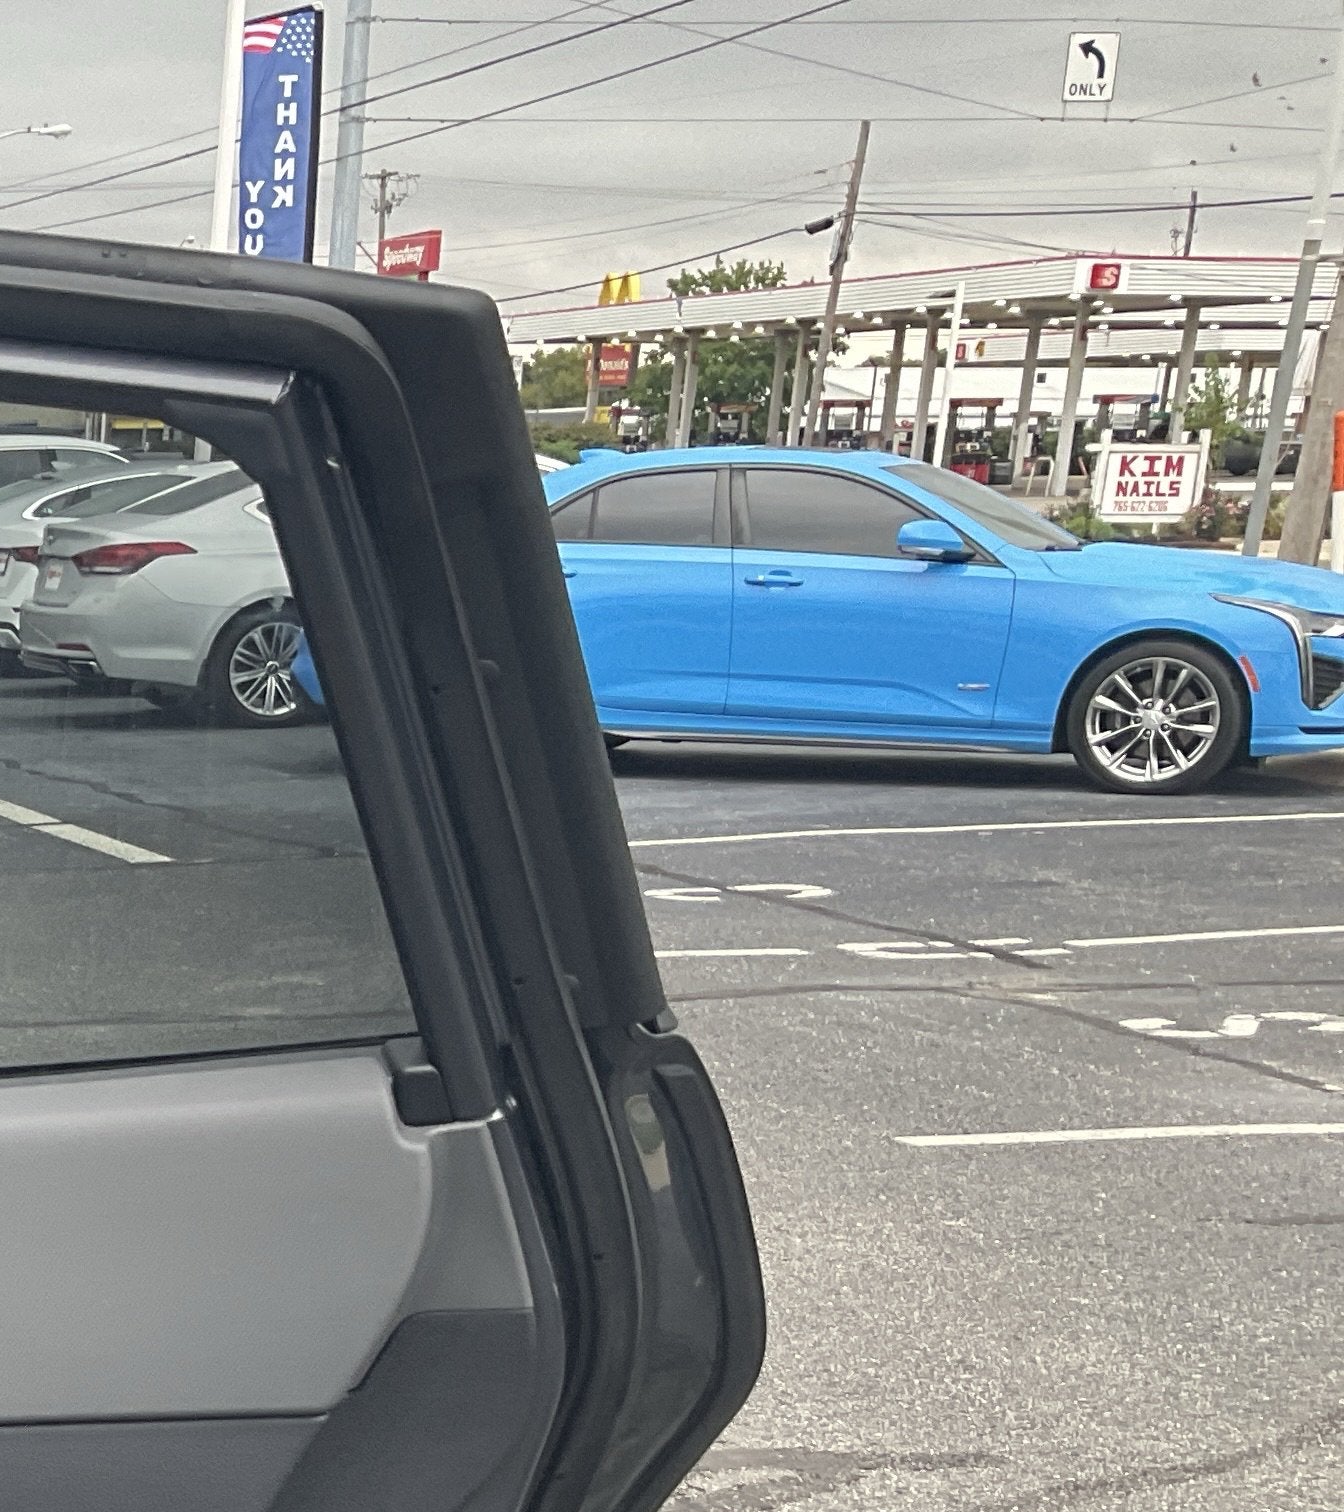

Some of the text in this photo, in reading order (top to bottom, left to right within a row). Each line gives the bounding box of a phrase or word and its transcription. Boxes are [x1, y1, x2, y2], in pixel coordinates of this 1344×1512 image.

[1069, 83, 1107, 96] ONLY
[1119, 455, 1185, 477] KIM
[1115, 481, 1181, 497] NAILS
